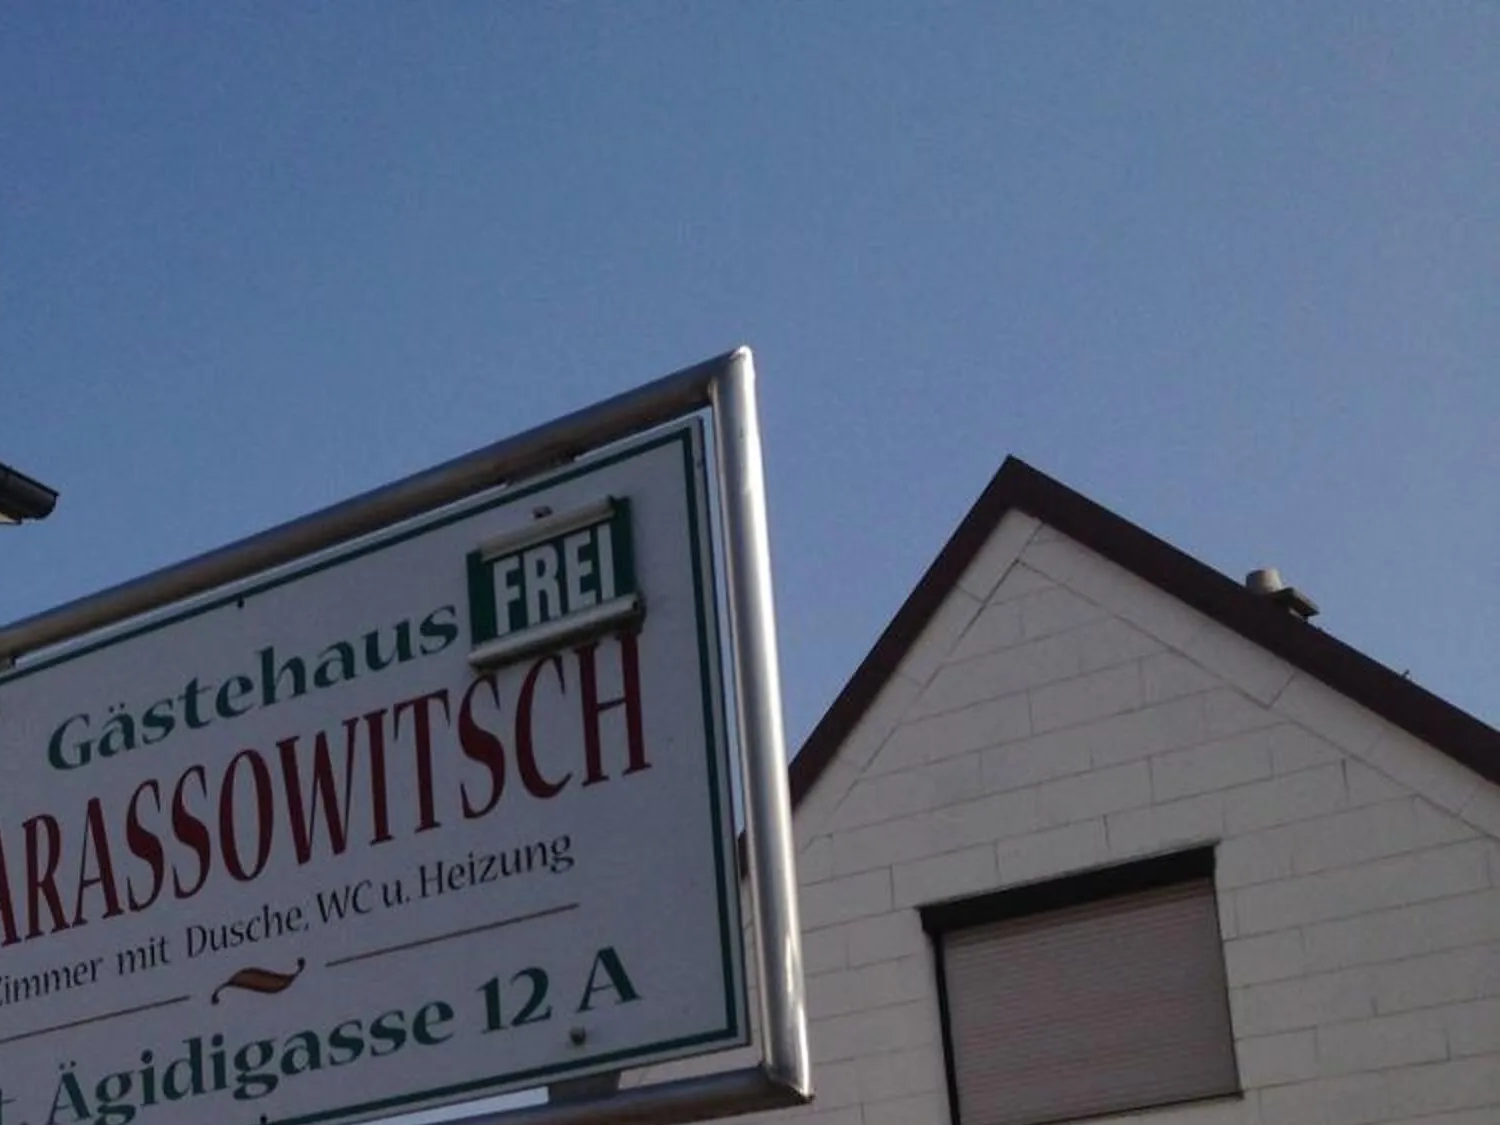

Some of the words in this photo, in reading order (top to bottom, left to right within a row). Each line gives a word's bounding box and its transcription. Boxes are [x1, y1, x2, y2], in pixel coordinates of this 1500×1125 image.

[493, 522, 616, 638] FREI
[47, 603, 459, 771] Gästehaus
[116, 935, 171, 975] mit
[315, 879, 373, 924] WC
[381, 878, 412, 909] u.
[417, 833, 577, 898] Heizung
[474, 965, 555, 1035] 12
[576, 945, 644, 1014] A
